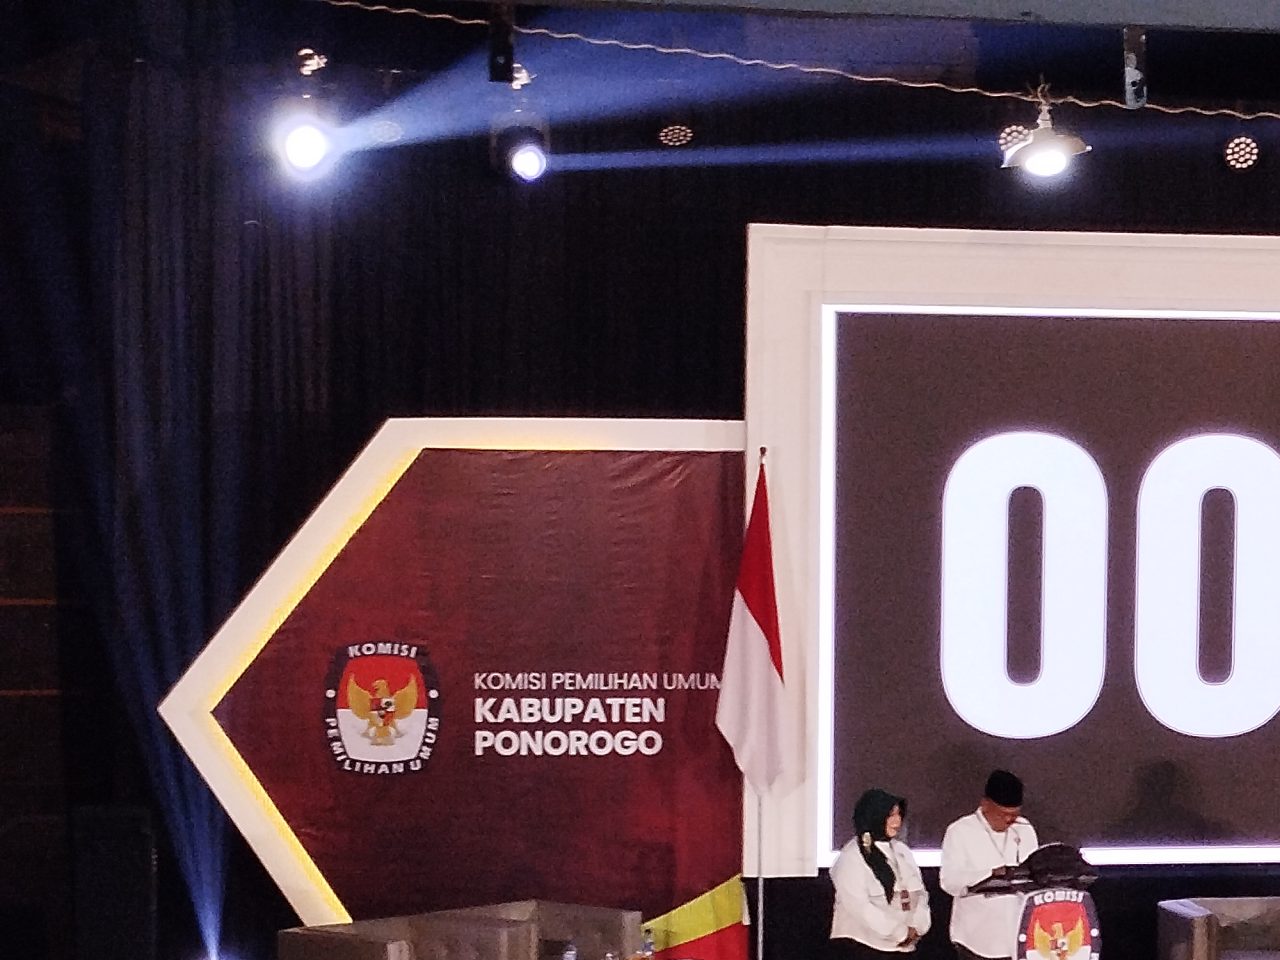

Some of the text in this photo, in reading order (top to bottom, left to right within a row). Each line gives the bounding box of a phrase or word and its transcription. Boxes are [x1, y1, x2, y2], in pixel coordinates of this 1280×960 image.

[348, 642, 418, 658] KOMISI
[474, 672, 546, 690] KOMISI
[552, 672, 657, 690] PEMILIHAN
[474, 697, 665, 723] KABUPATEN
[325, 717, 440, 774] PEMILIHAN UMUM
[474, 730, 663, 756] PONOROGO
[1034, 890, 1084, 906] KOMISI
